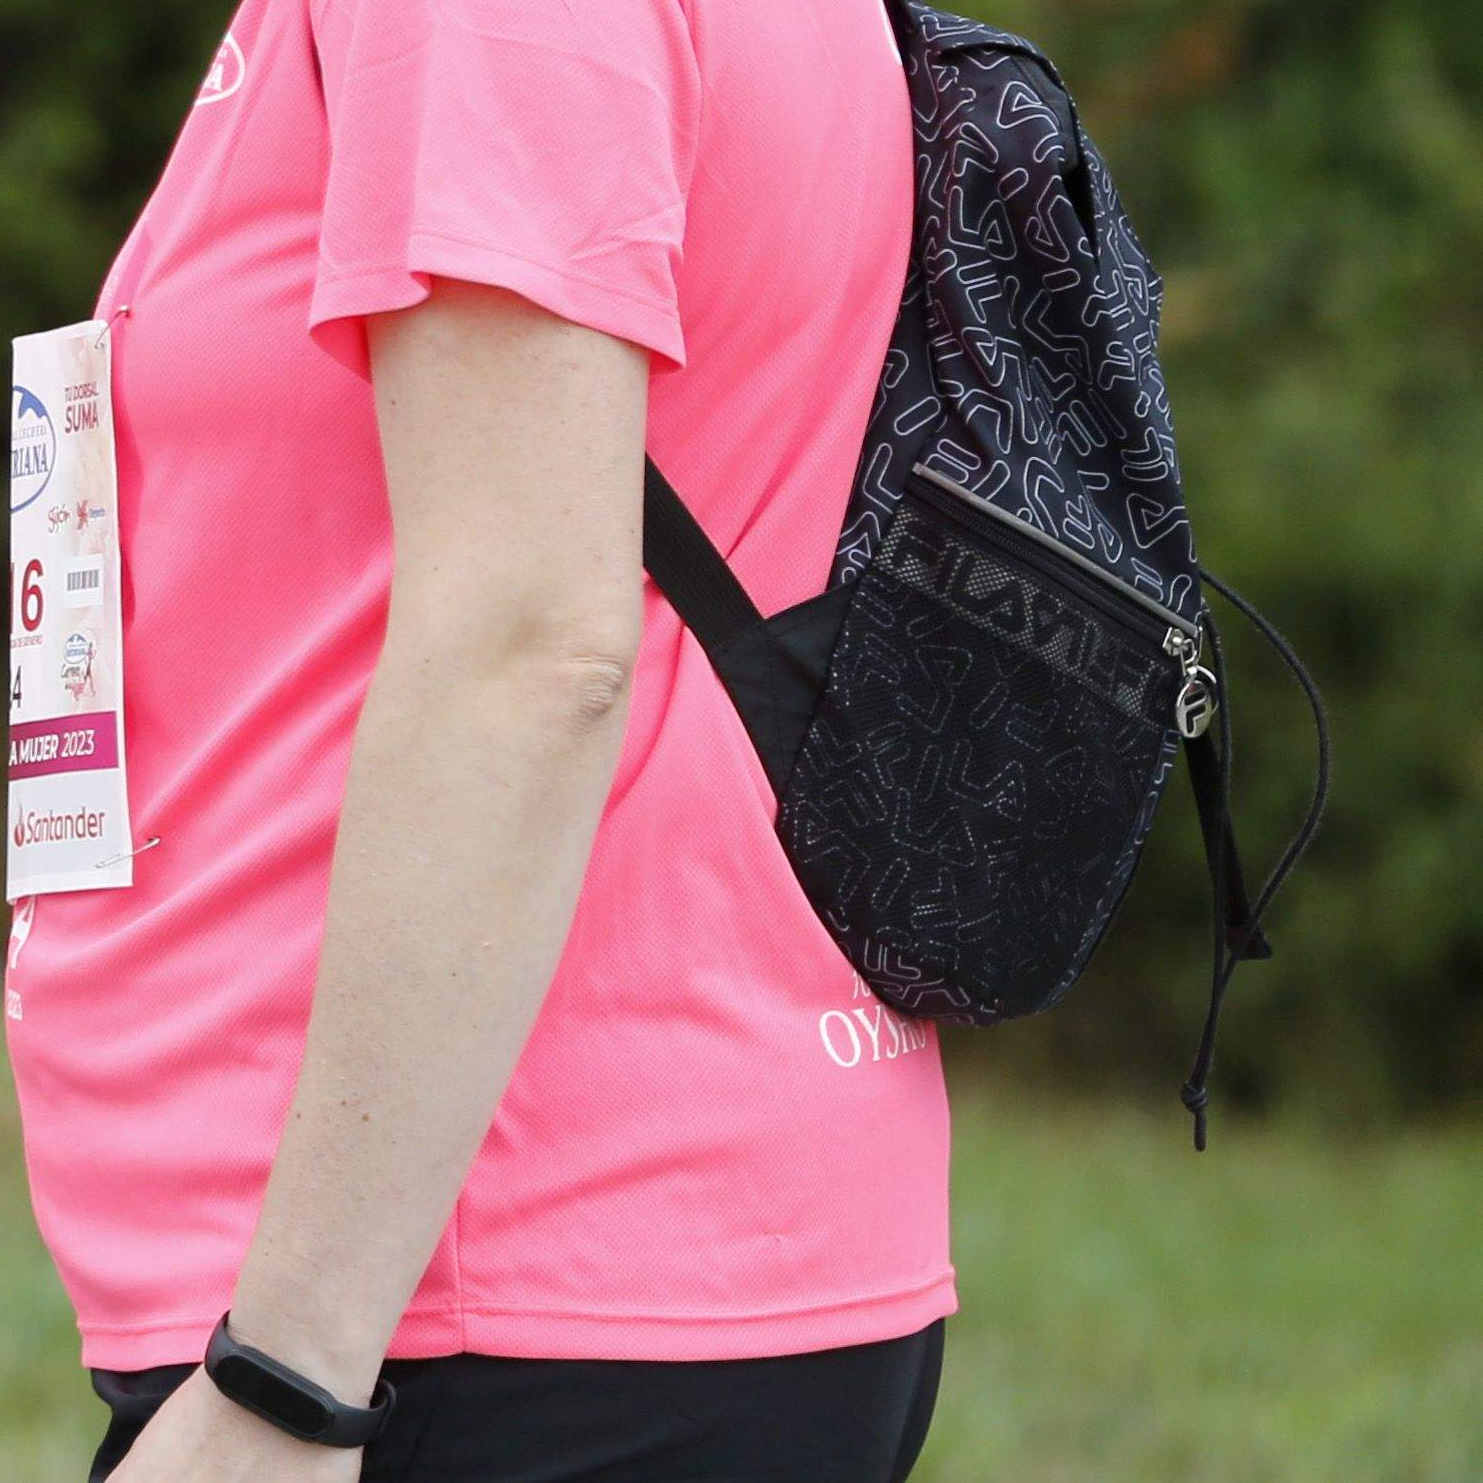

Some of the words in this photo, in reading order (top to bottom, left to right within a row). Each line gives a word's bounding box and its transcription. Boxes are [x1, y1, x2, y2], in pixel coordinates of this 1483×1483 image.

[64, 401, 99, 434] SUMA
[11, 442, 49, 479] RIANA
[8, 740, 18, 766] A
[19, 734, 59, 765] MUJER
[61, 729, 95, 758] 2023
[26, 806, 106, 845] Santander
